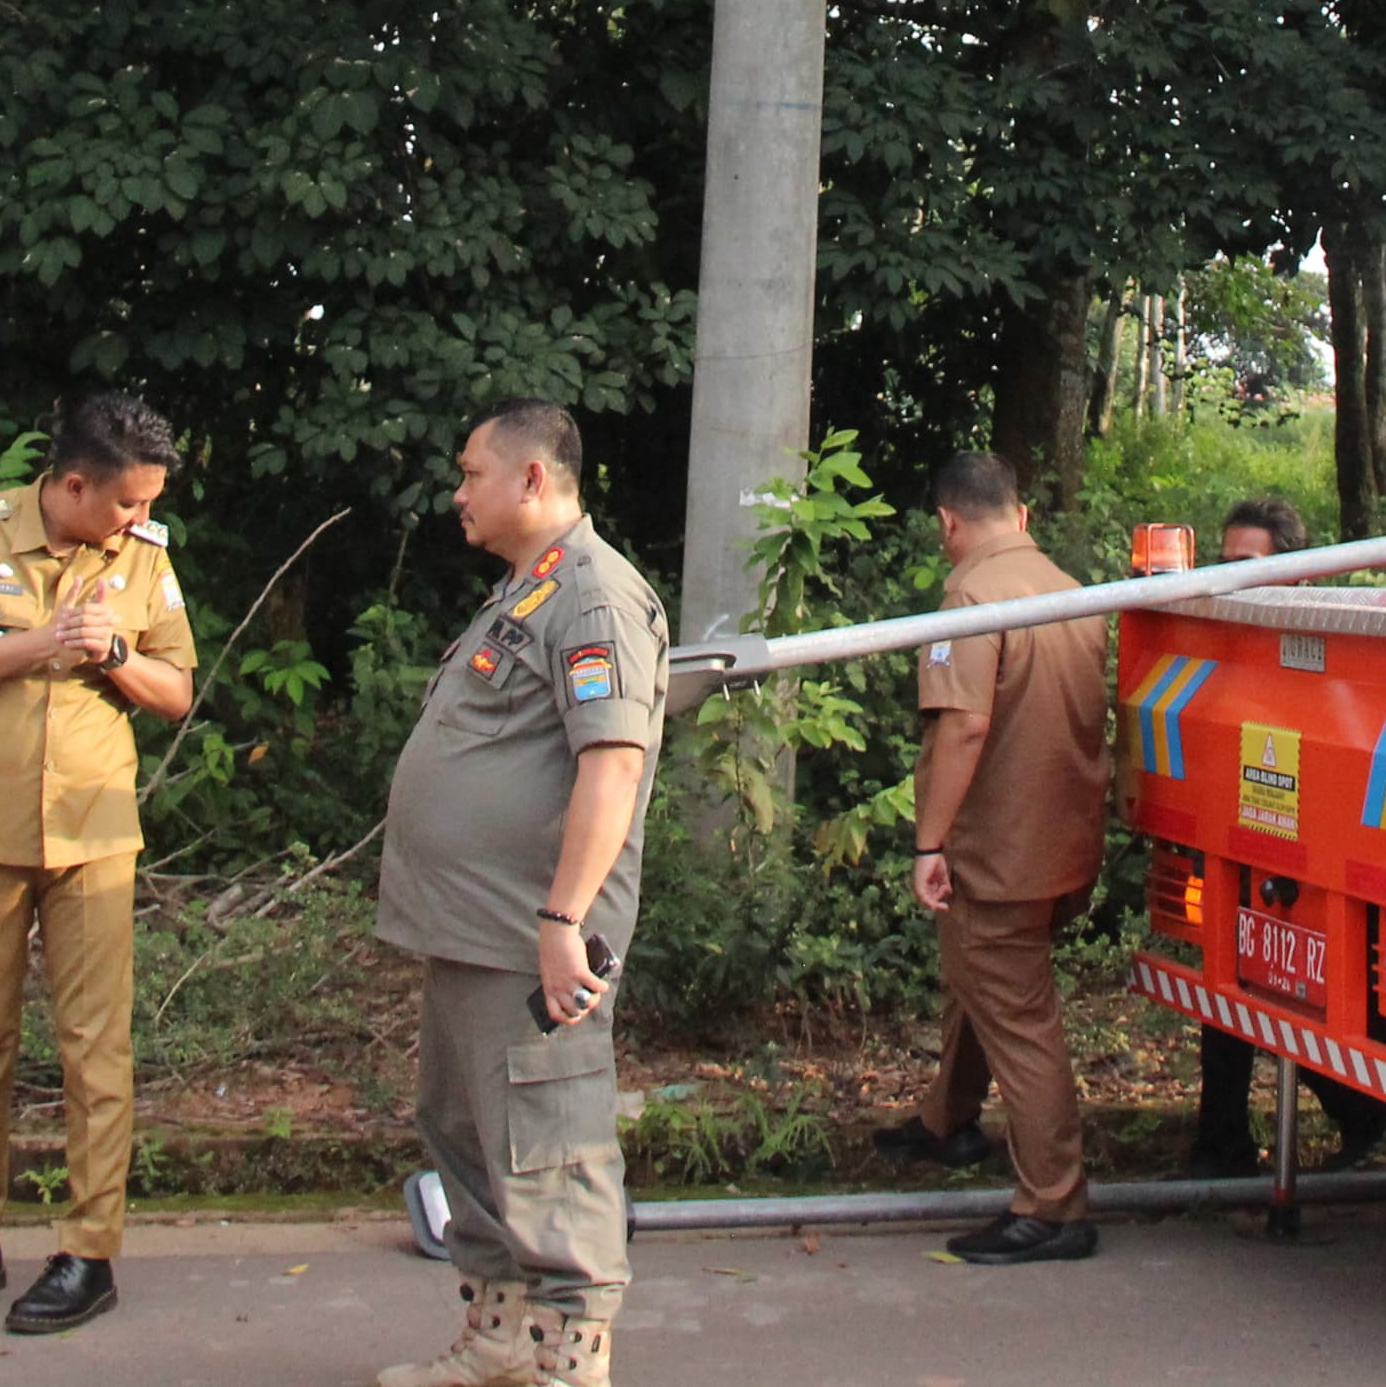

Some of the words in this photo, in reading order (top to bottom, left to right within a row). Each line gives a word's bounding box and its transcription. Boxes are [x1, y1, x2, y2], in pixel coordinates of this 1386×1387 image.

[1245, 767, 1260, 784] AREA
[1260, 771, 1278, 787] BLIND
[1278, 774, 1294, 790] SPOT
[1238, 912, 1255, 957] BG
[1263, 921, 1296, 975] 8112
[1307, 936, 1325, 984] RZ
